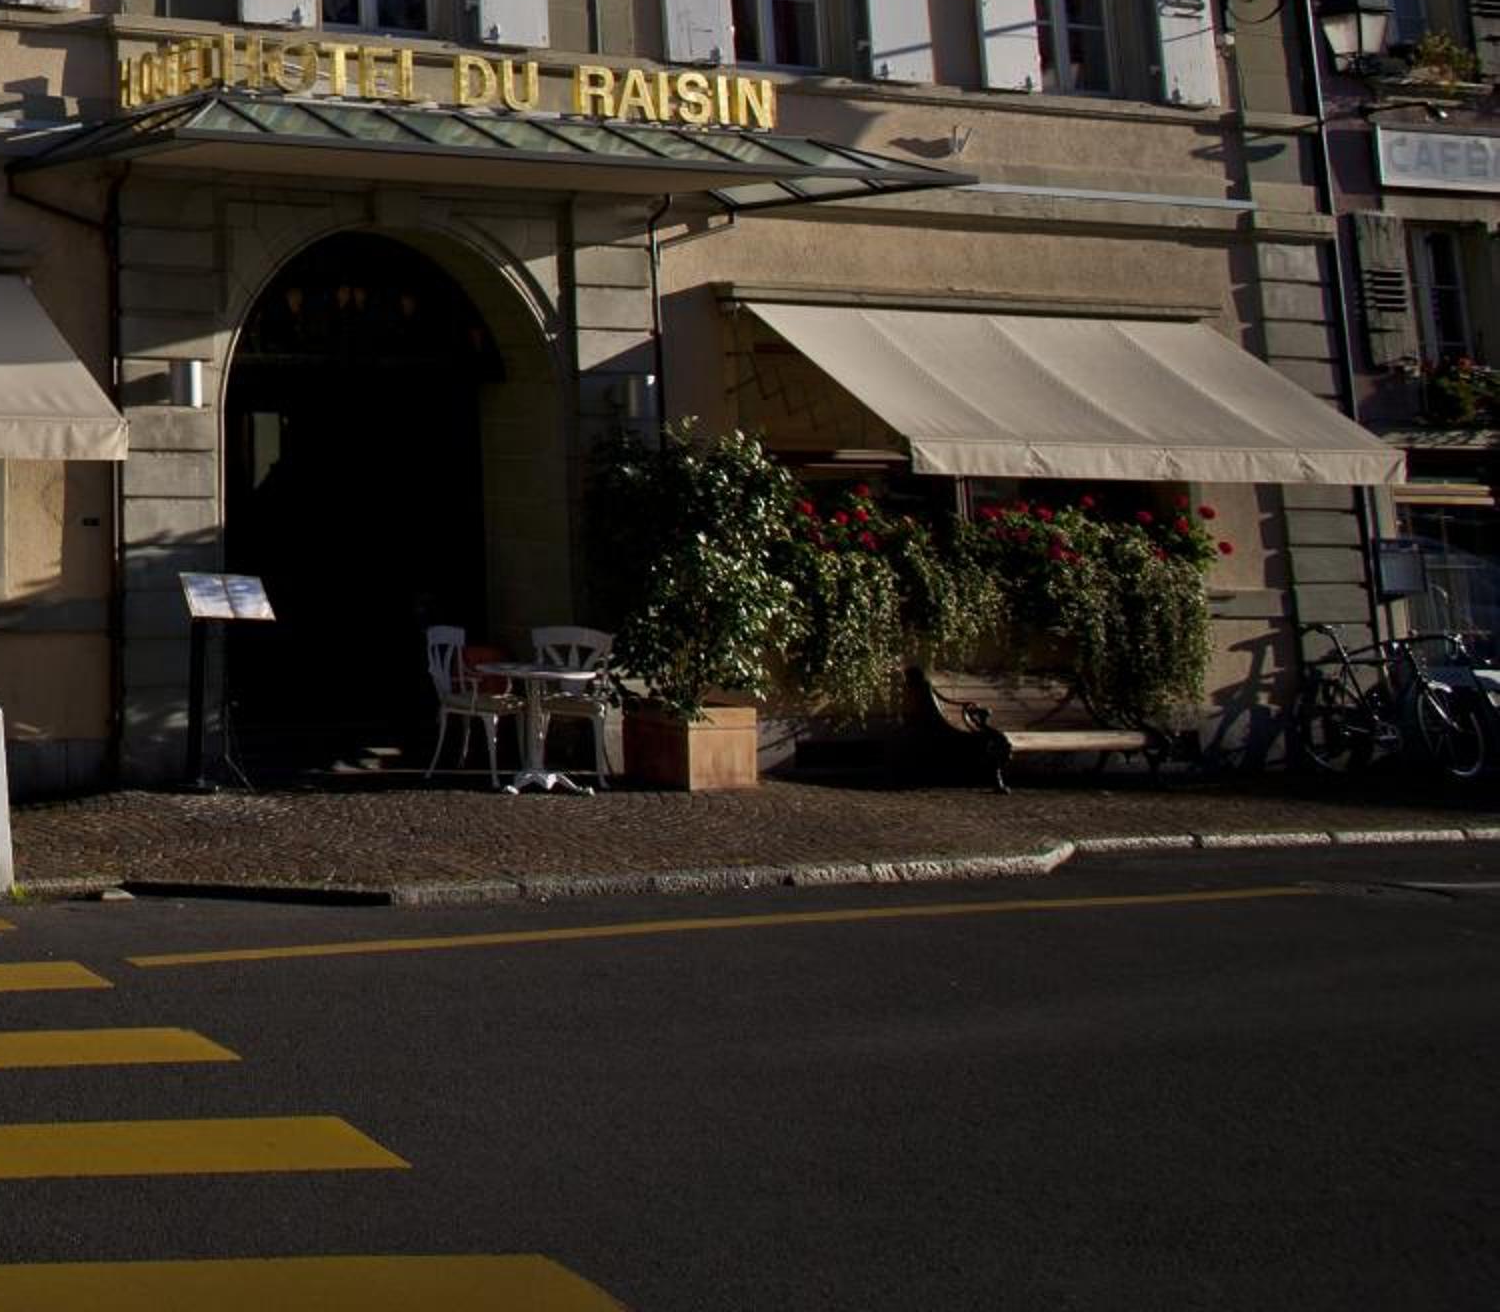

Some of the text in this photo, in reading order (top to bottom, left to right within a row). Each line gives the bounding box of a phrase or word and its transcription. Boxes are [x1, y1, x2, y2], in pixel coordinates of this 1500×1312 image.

[222, 32, 775, 128] HOTEL DU RAISIN
